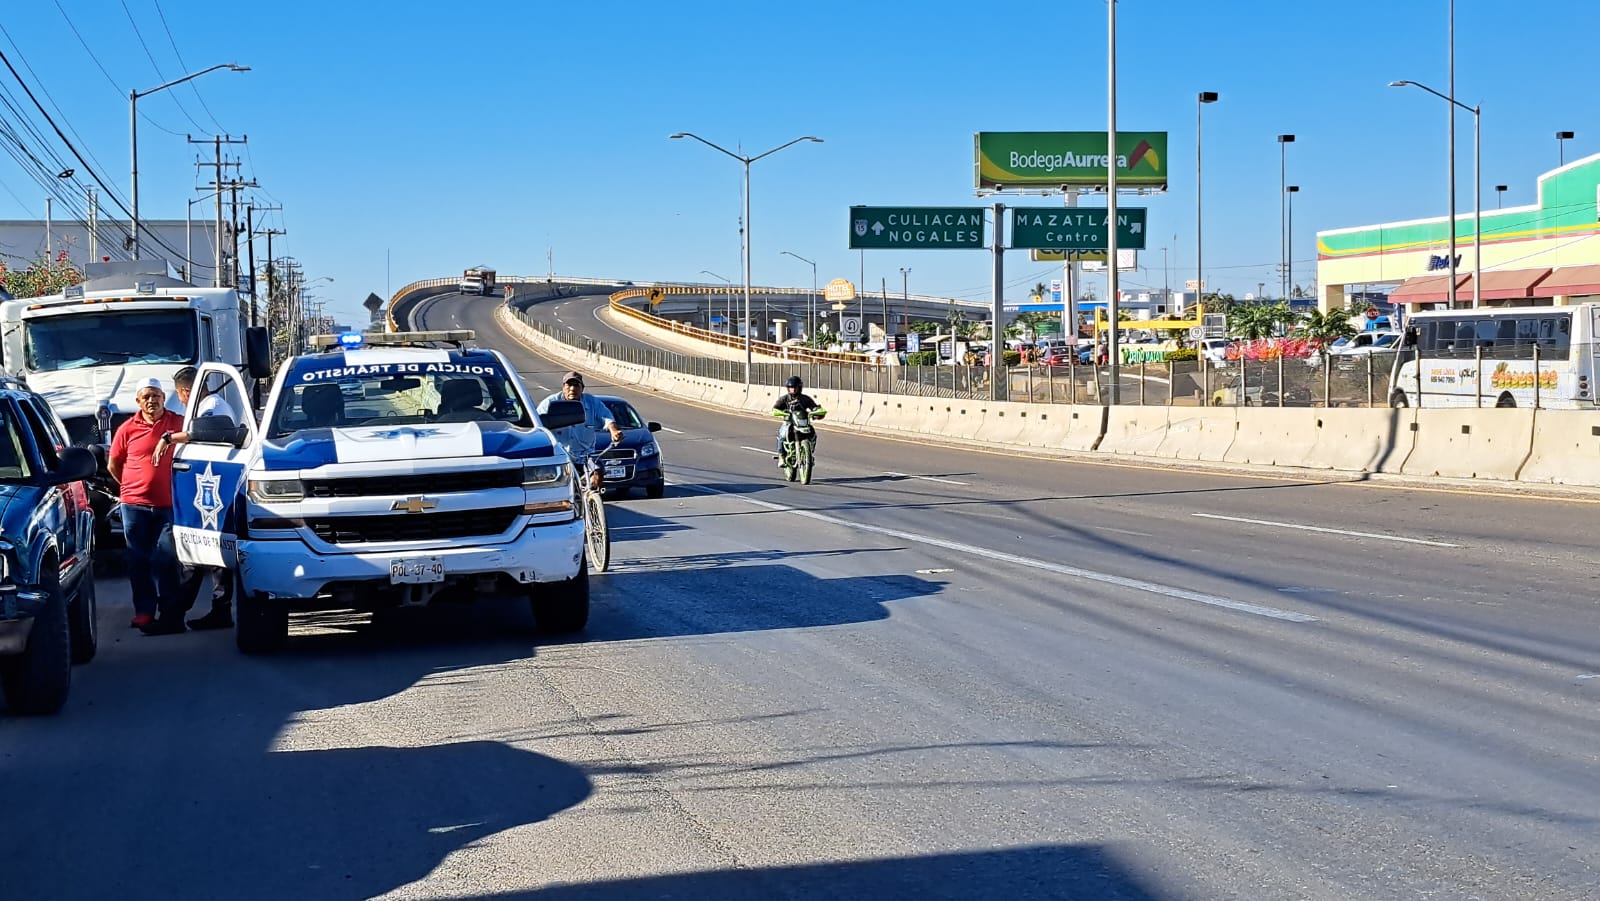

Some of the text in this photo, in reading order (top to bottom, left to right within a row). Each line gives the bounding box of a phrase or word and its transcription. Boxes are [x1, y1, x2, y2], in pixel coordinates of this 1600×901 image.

[1010, 151, 1127, 172] BodegaAurrea
[888, 214, 980, 225] CULIACAN
[1017, 214, 1128, 226] MAZATLAN
[857, 224, 865, 232] 15
[889, 231, 979, 242] NOGALES
[1046, 232, 1098, 242] Centro
[392, 563, 443, 577] POL-37-40
